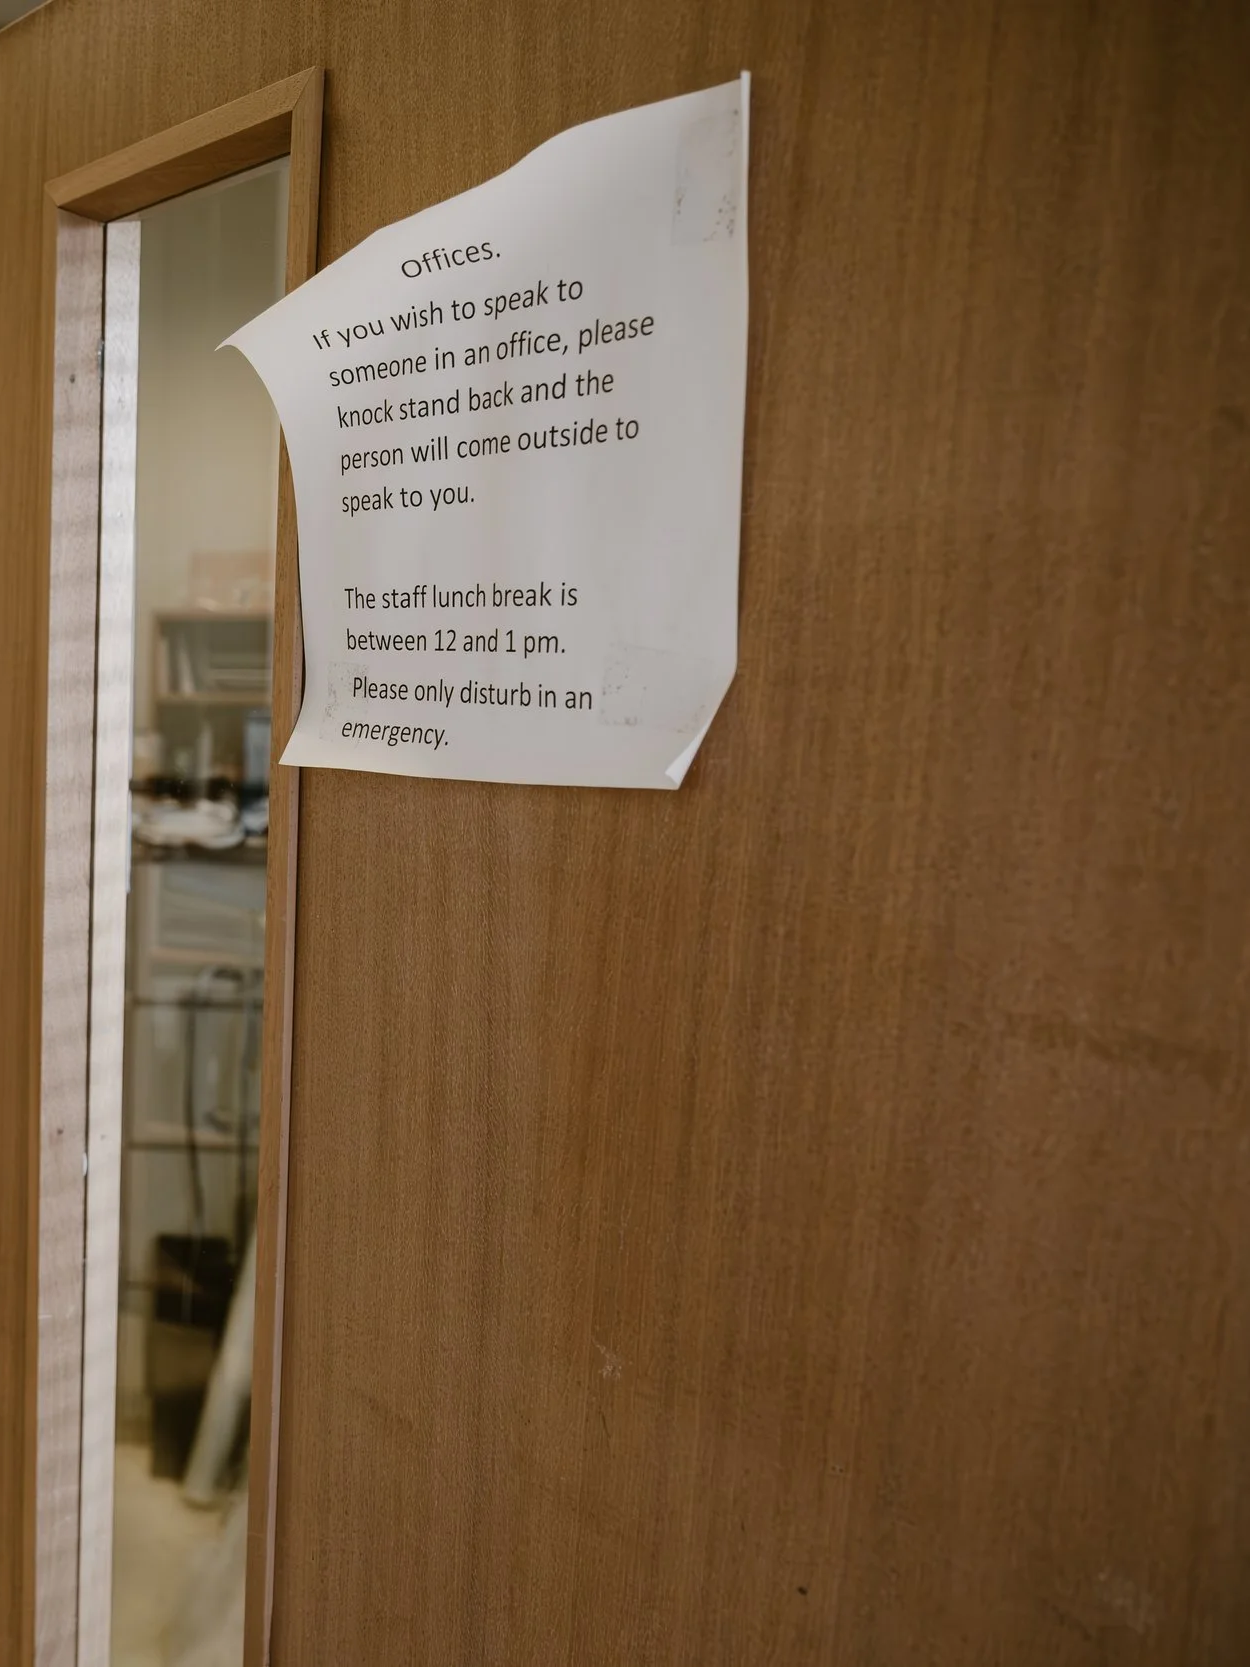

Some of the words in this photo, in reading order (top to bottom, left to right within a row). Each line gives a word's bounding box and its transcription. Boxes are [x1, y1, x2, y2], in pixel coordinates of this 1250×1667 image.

[400, 242, 501, 279] Offices.
[312, 329, 331, 350] If
[336, 319, 385, 348] you
[389, 300, 443, 332] wish
[450, 299, 476, 322] to
[483, 279, 549, 321] speak
[556, 279, 584, 302] to
[329, 355, 427, 387] someone
[434, 346, 455, 371] in
[464, 345, 490, 367] an
[496, 329, 569, 361] office,
[578, 315, 655, 355] please
[337, 398, 394, 429] knock
[399, 388, 460, 421] stand
[468, 380, 514, 412] back
[520, 372, 567, 404] and
[575, 369, 614, 397] the
[341, 447, 404, 477] person
[410, 435, 449, 463] will
[456, 434, 511, 459] come
[517, 417, 608, 451] outside
[615, 417, 640, 441] to
[341, 485, 394, 518] speak
[399, 487, 423, 509] to
[429, 485, 475, 512] you.
[343, 586, 376, 610] The
[381, 584, 428, 609] staff
[432, 583, 486, 608] lunch
[492, 581, 552, 608] break
[561, 581, 578, 607] is
[346, 627, 427, 652] between
[434, 629, 457, 652] 12
[462, 627, 499, 653] and
[505, 629, 517, 653] 1
[524, 635, 566, 660] pm.
[352, 675, 409, 701] Please
[414, 678, 455, 709] only
[459, 679, 532, 707] disturb
[538, 683, 557, 709] in
[564, 690, 593, 711] an
[341, 721, 449, 751] emergency.
